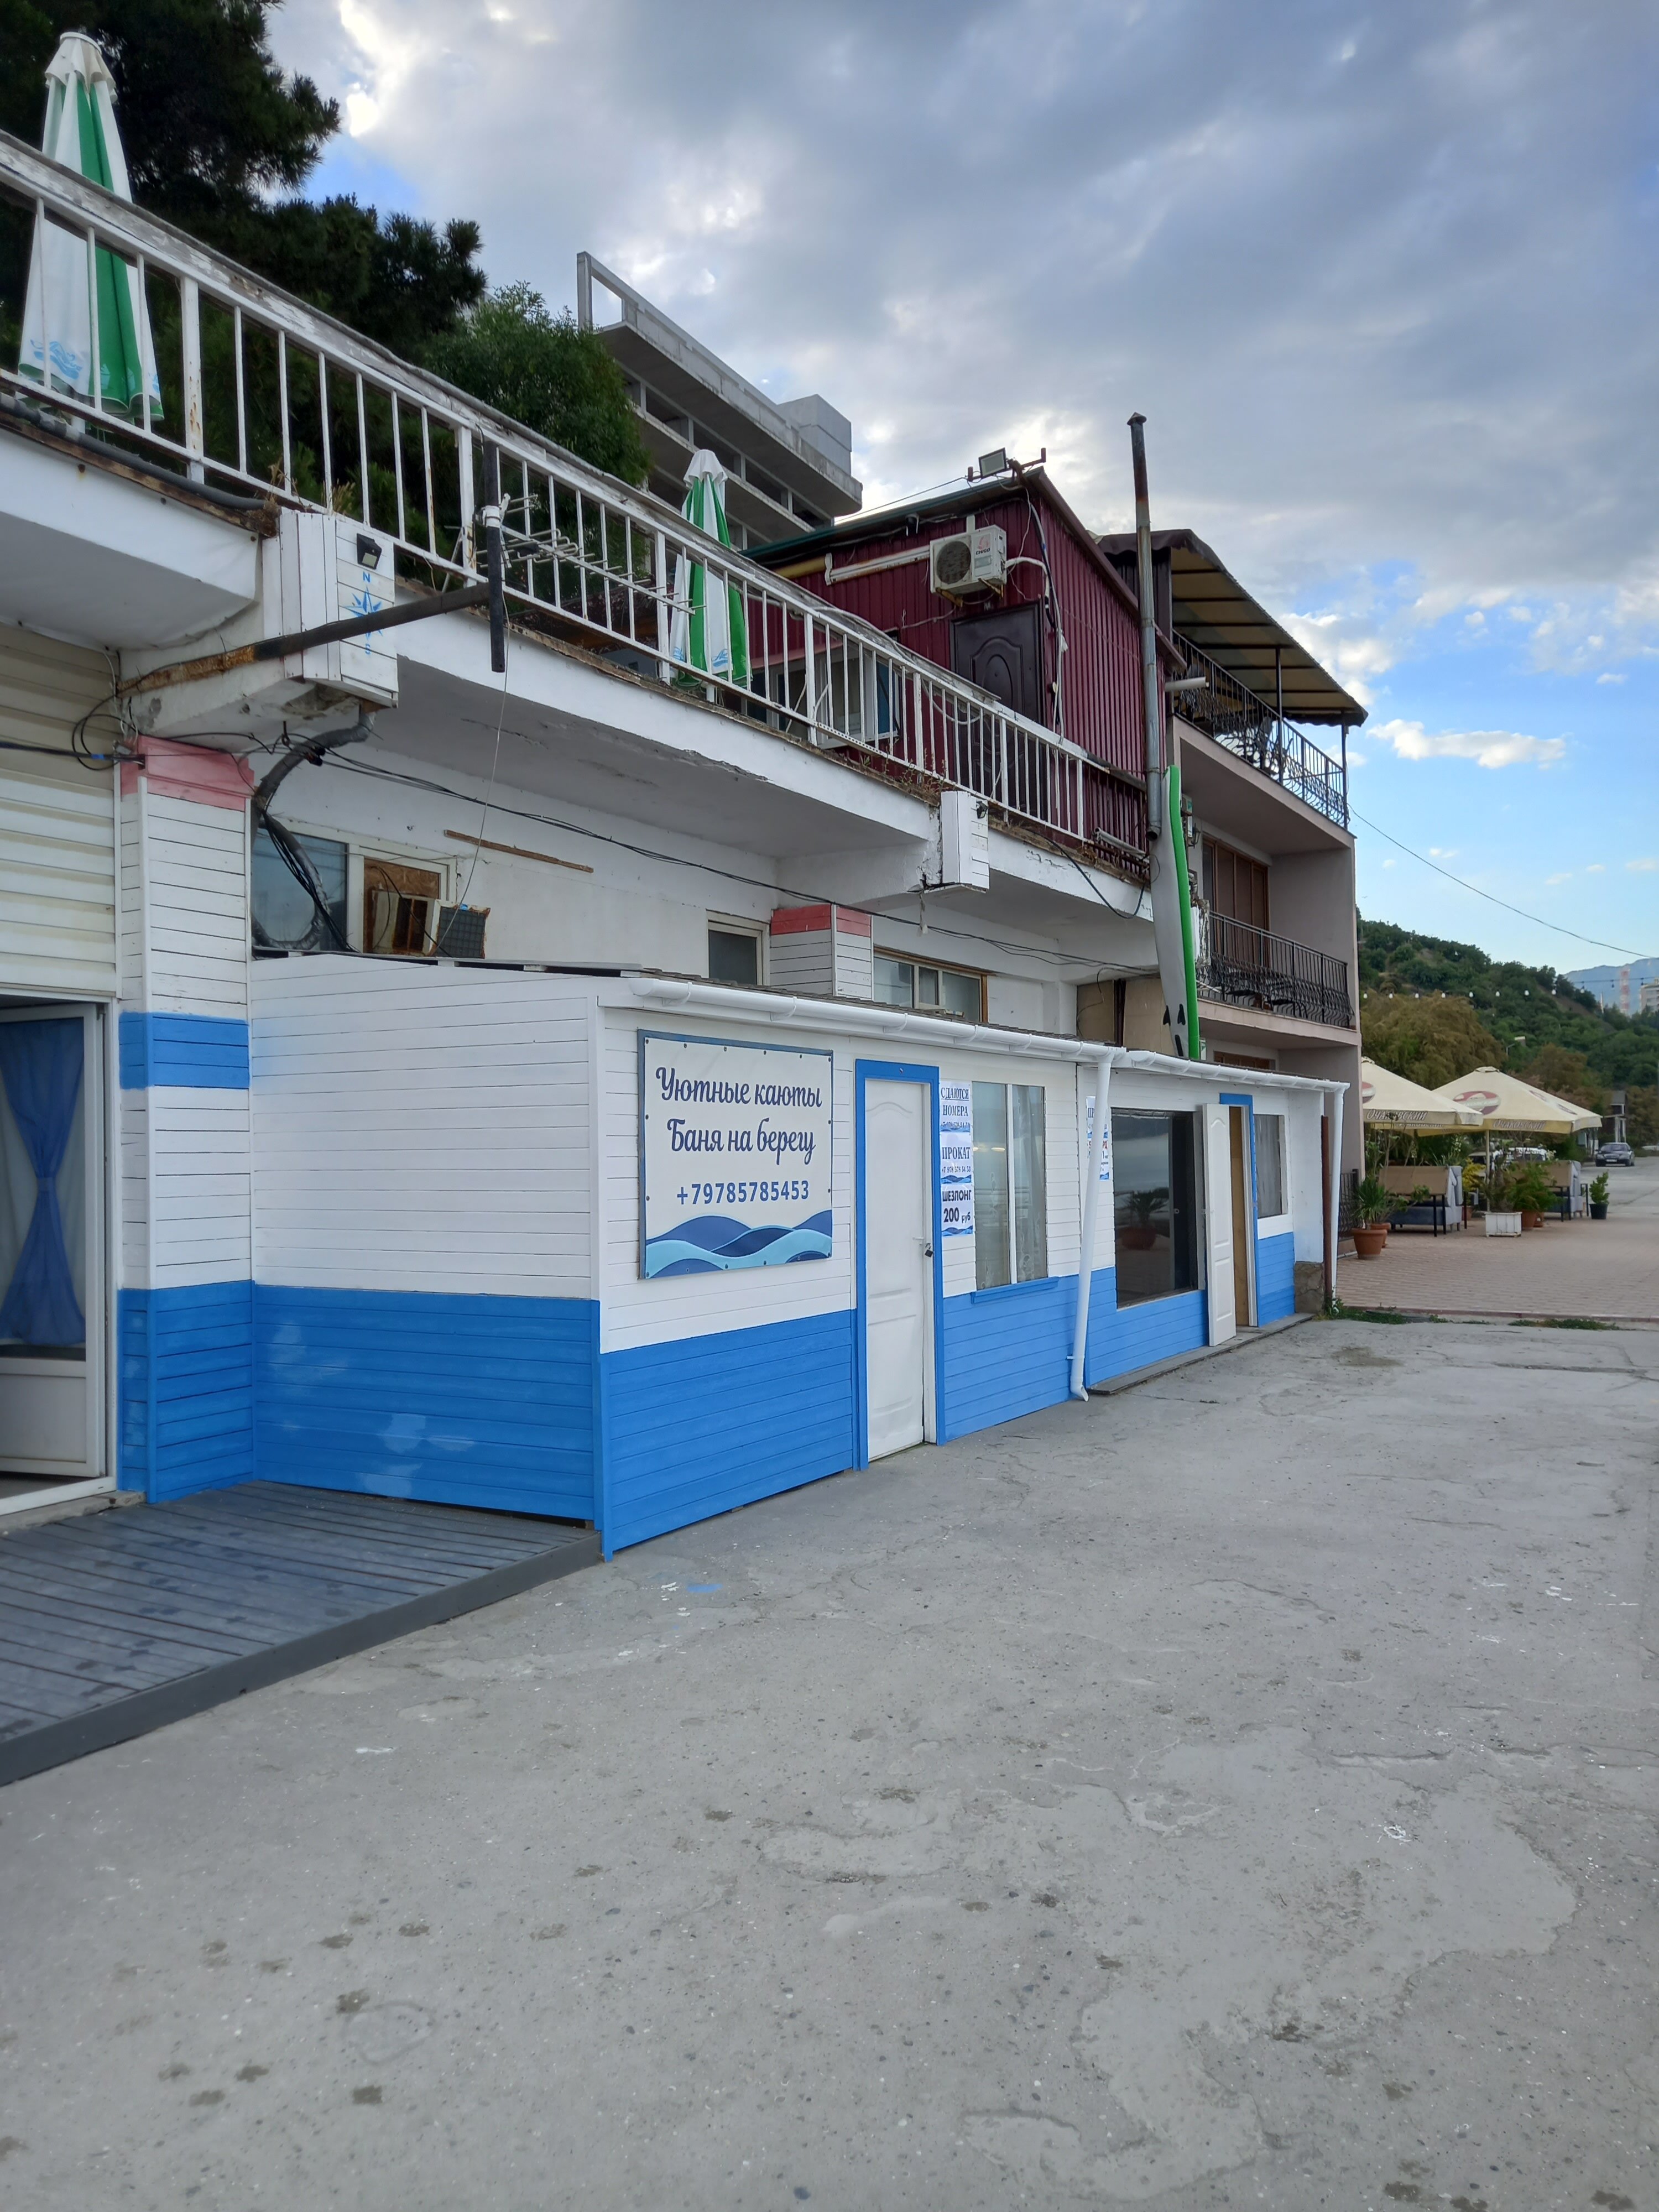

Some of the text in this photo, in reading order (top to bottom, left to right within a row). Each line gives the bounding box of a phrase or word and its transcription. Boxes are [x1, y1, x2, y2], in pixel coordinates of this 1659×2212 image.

[975, 547, 990, 555] CHIGO
[363, 571, 371, 583] N
[656, 1067, 823, 1108] Уютные каюты
[941, 1087, 969, 1100] СДАЮТСЯ
[943, 1105, 968, 1117] НОМЕРА
[667, 1118, 816, 1166] Баня на берегу
[942, 1147, 971, 1160] ПРОКАТ
[677, 1181, 810, 1205] +79785785453
[942, 1190, 972, 1202] ШЕЗЛОНГ
[943, 1207, 971, 1223] 200 руб
